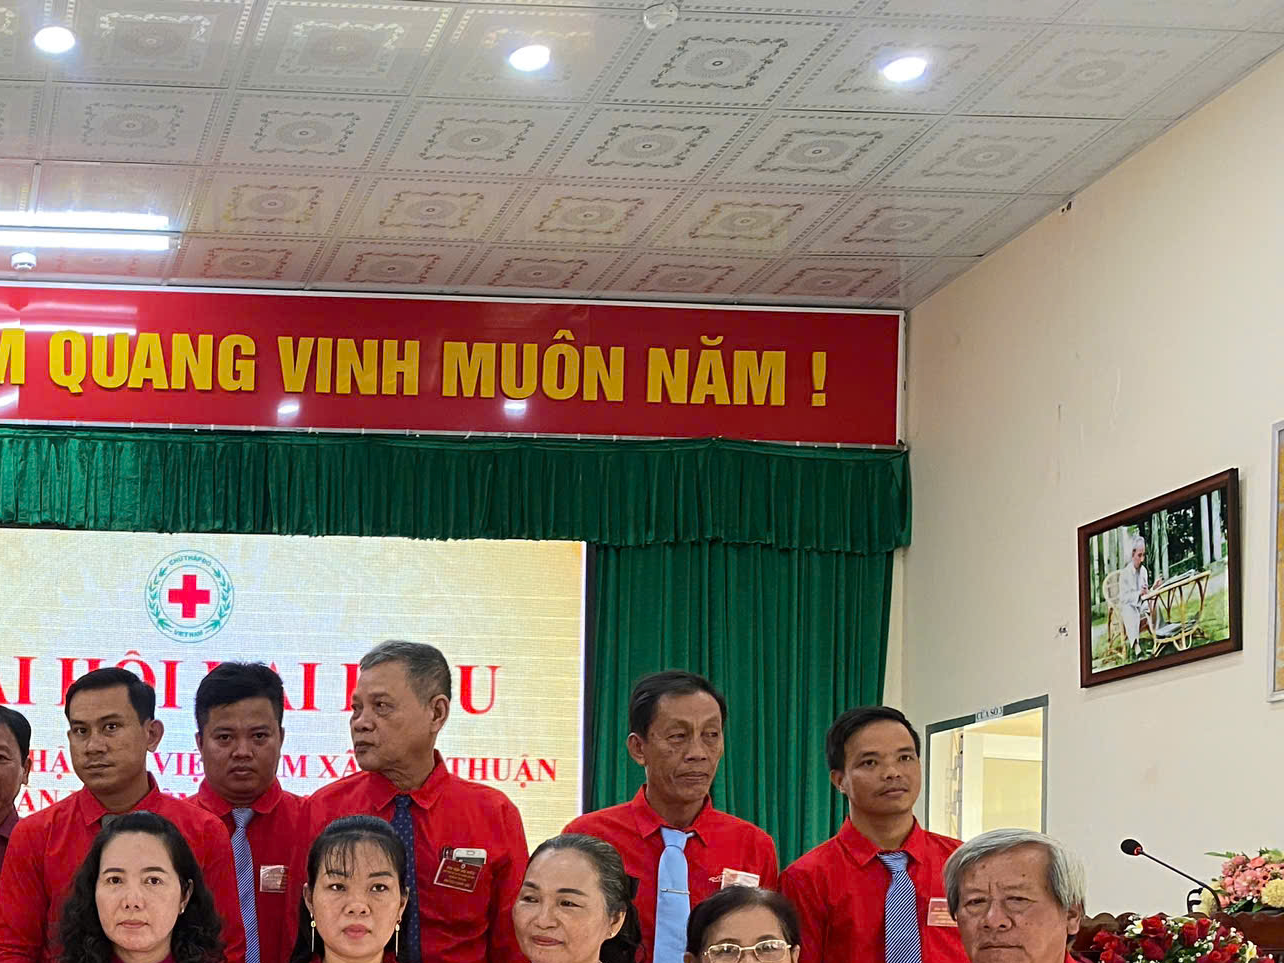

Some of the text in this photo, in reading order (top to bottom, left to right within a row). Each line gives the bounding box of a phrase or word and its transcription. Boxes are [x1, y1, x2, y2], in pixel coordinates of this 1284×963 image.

[49, 330, 256, 393] QUANG
[278, 336, 421, 396] VINH
[443, 329, 625, 402] MUÔN
[647, 335, 787, 406] NĂM
[811, 351, 828, 407] !
[445, 753, 557, 789] THUẬN
